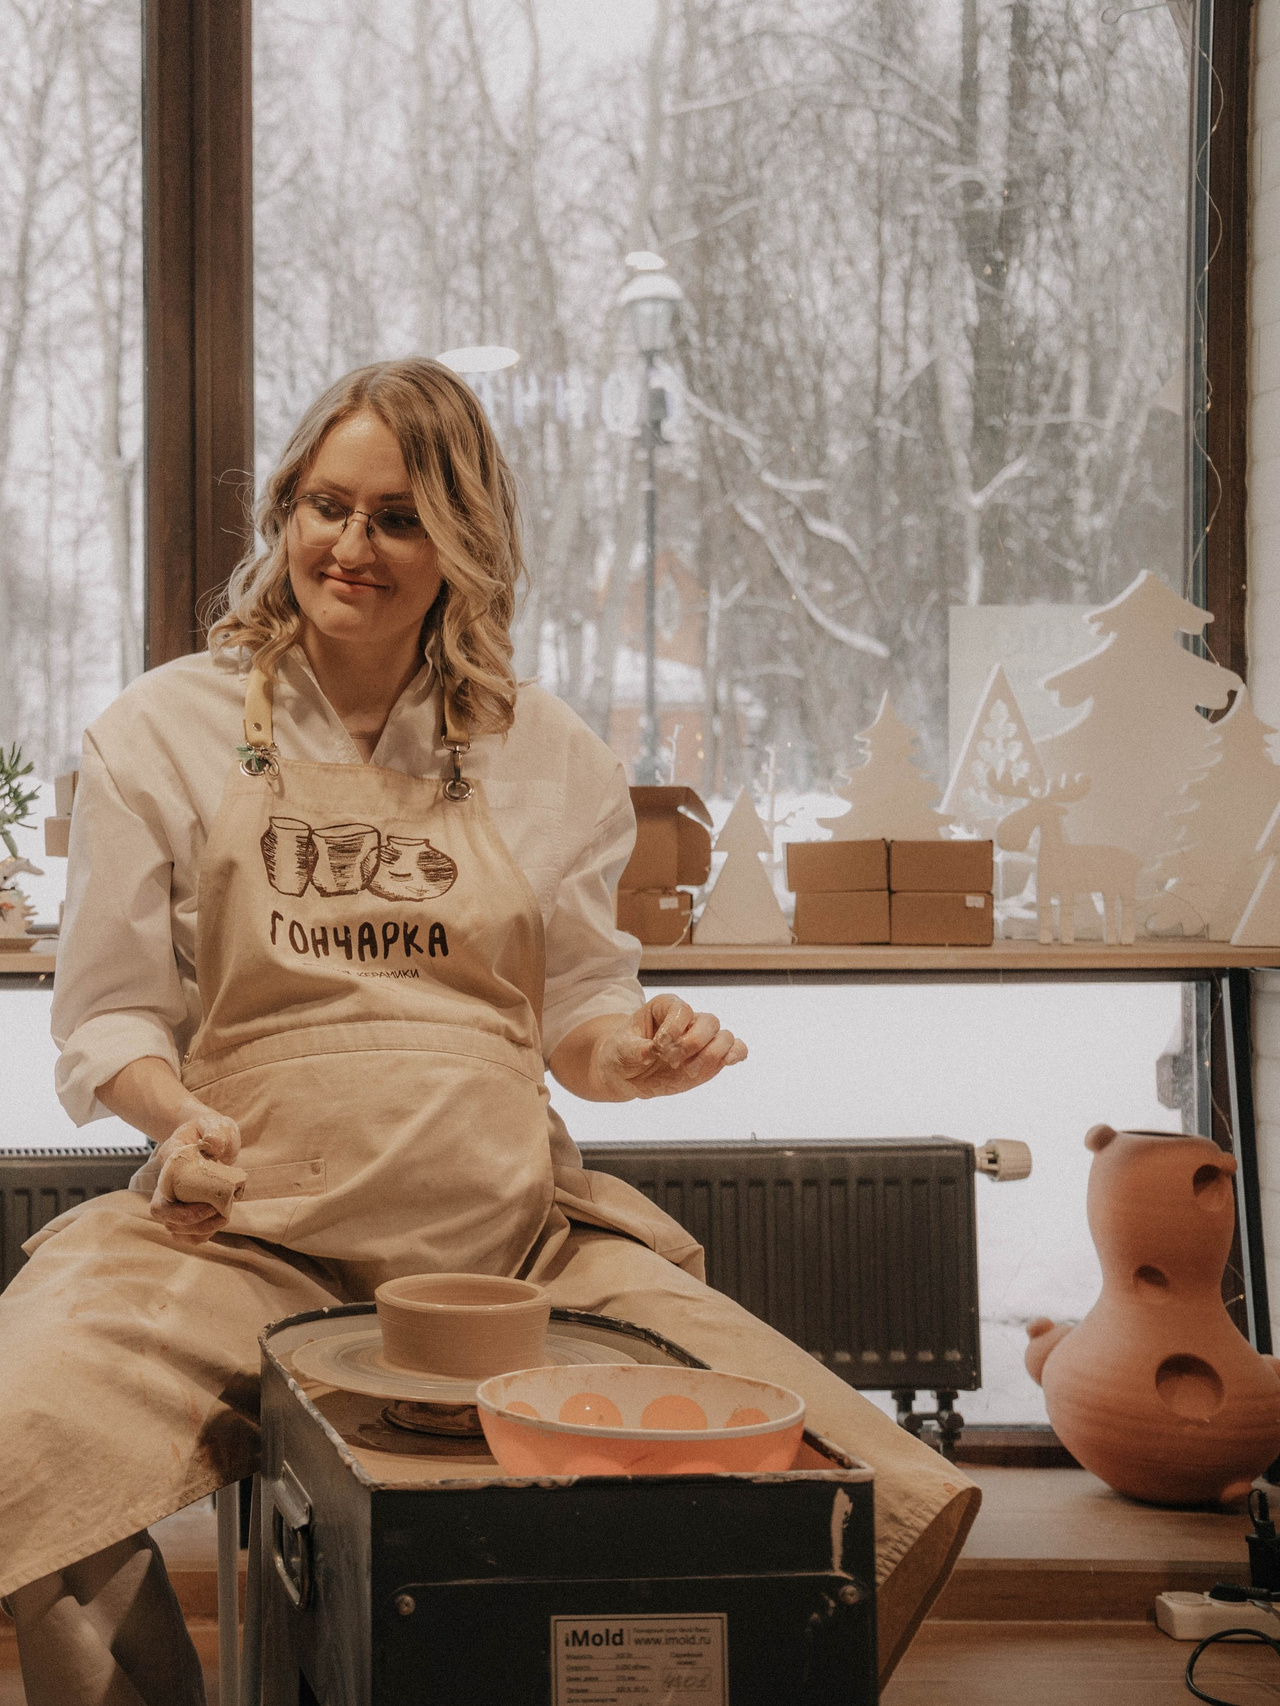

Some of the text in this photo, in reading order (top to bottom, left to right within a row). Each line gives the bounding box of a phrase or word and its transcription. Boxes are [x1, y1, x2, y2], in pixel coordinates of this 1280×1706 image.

[269, 910, 450, 962] ГОНЧАРКА
[565, 1628, 624, 1647] iMold
[634, 1634, 711, 1646] www.imold.ru
